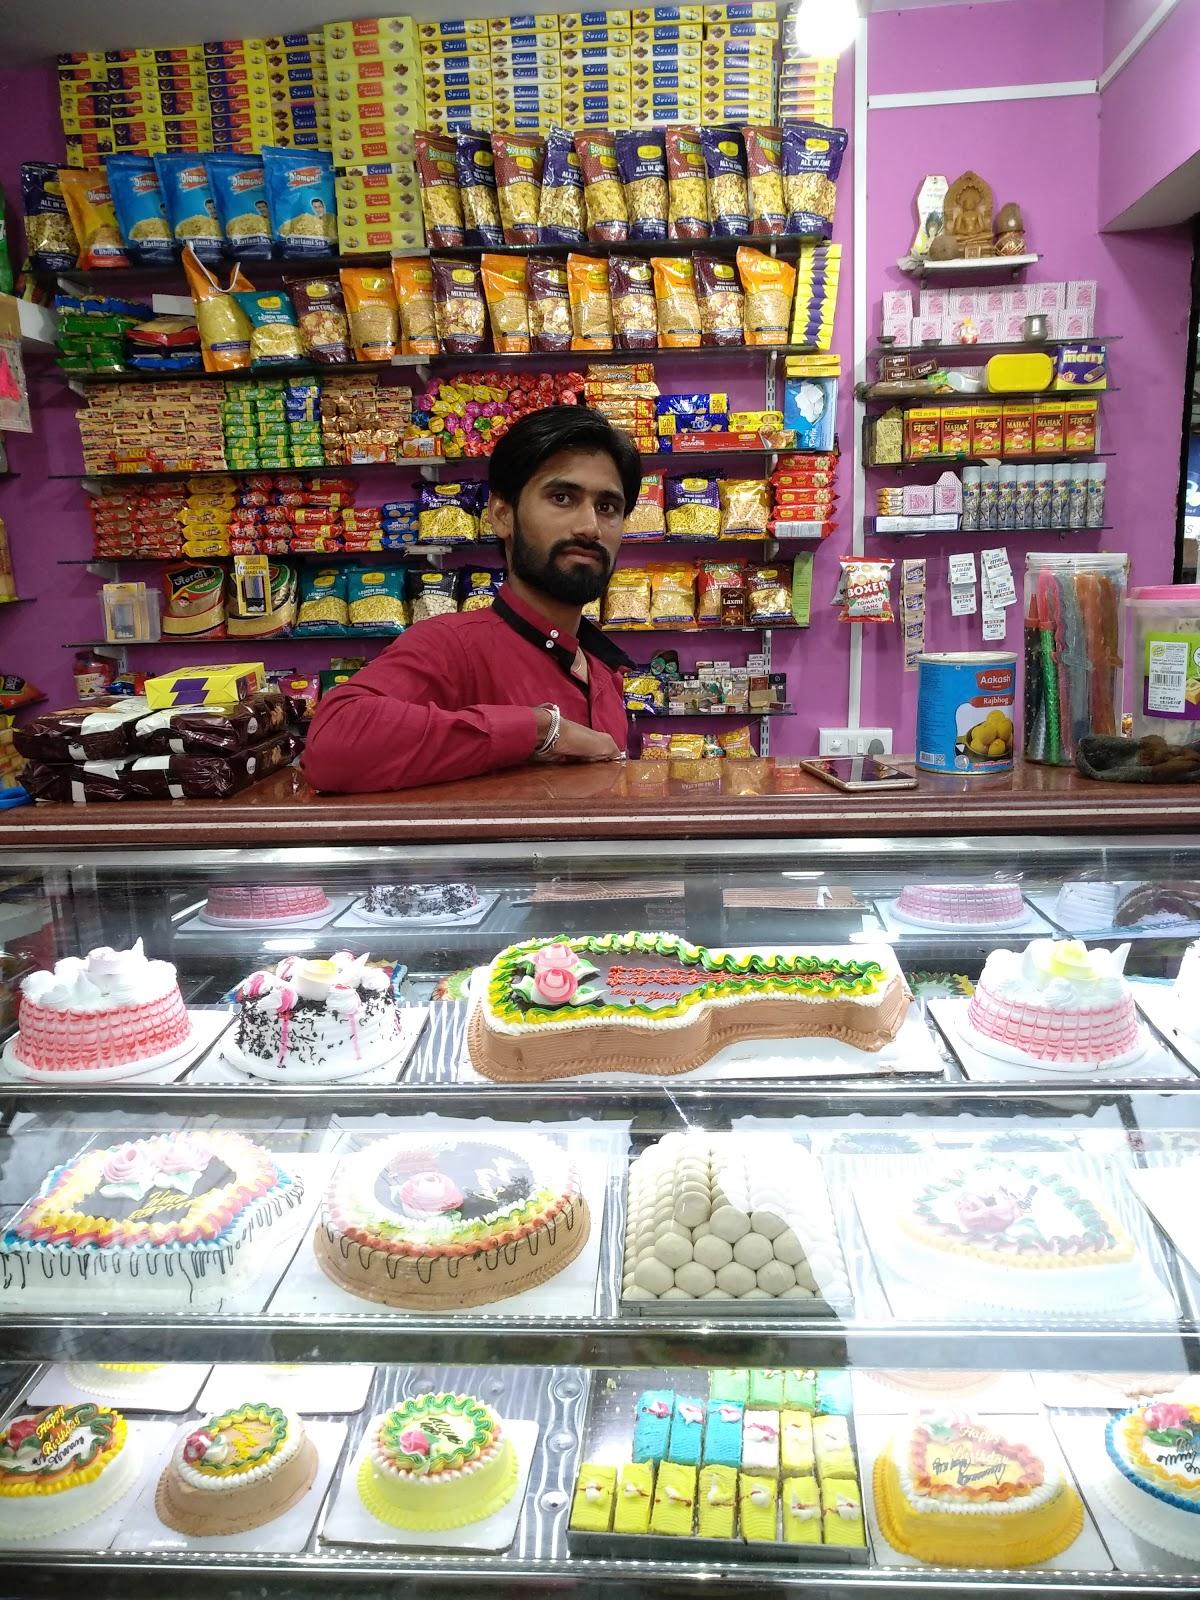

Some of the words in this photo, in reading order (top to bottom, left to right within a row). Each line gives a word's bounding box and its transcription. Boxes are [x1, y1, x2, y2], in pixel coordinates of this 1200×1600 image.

[656, 10, 679, 18] Sweets
[728, 7, 752, 16] Sweets
[442, 24, 465, 32] Sweets
[732, 26, 755, 34] Sweets
[585, 32, 607, 40] Sweets
[655, 30, 678, 38] Sweets
[290, 70, 312, 79] Sweets
[446, 75, 468, 83] Sweets
[292, 88, 313, 97] Sweets
[448, 107, 470, 115] Sweets
[654, 110, 677, 118] Sweets
[720, 160, 728, 168] ALL
[369, 165, 392, 174] Sweets
[181, 172, 208, 183] Diamon
[288, 172, 320, 183] Diamond
[290, 238, 314, 246] Ratlami
[1063, 353, 1104, 364] merry
[1037, 419, 1061, 427] MAHAK
[848, 581, 888, 597] BOXER
[857, 597, 883, 607] TOMATO
[980, 676, 1011, 684] Aakash
[984, 697, 1009, 705] Rajbhog
[36, 1406, 65, 1440] Happy
[42, 1414, 80, 1456] Birthday
